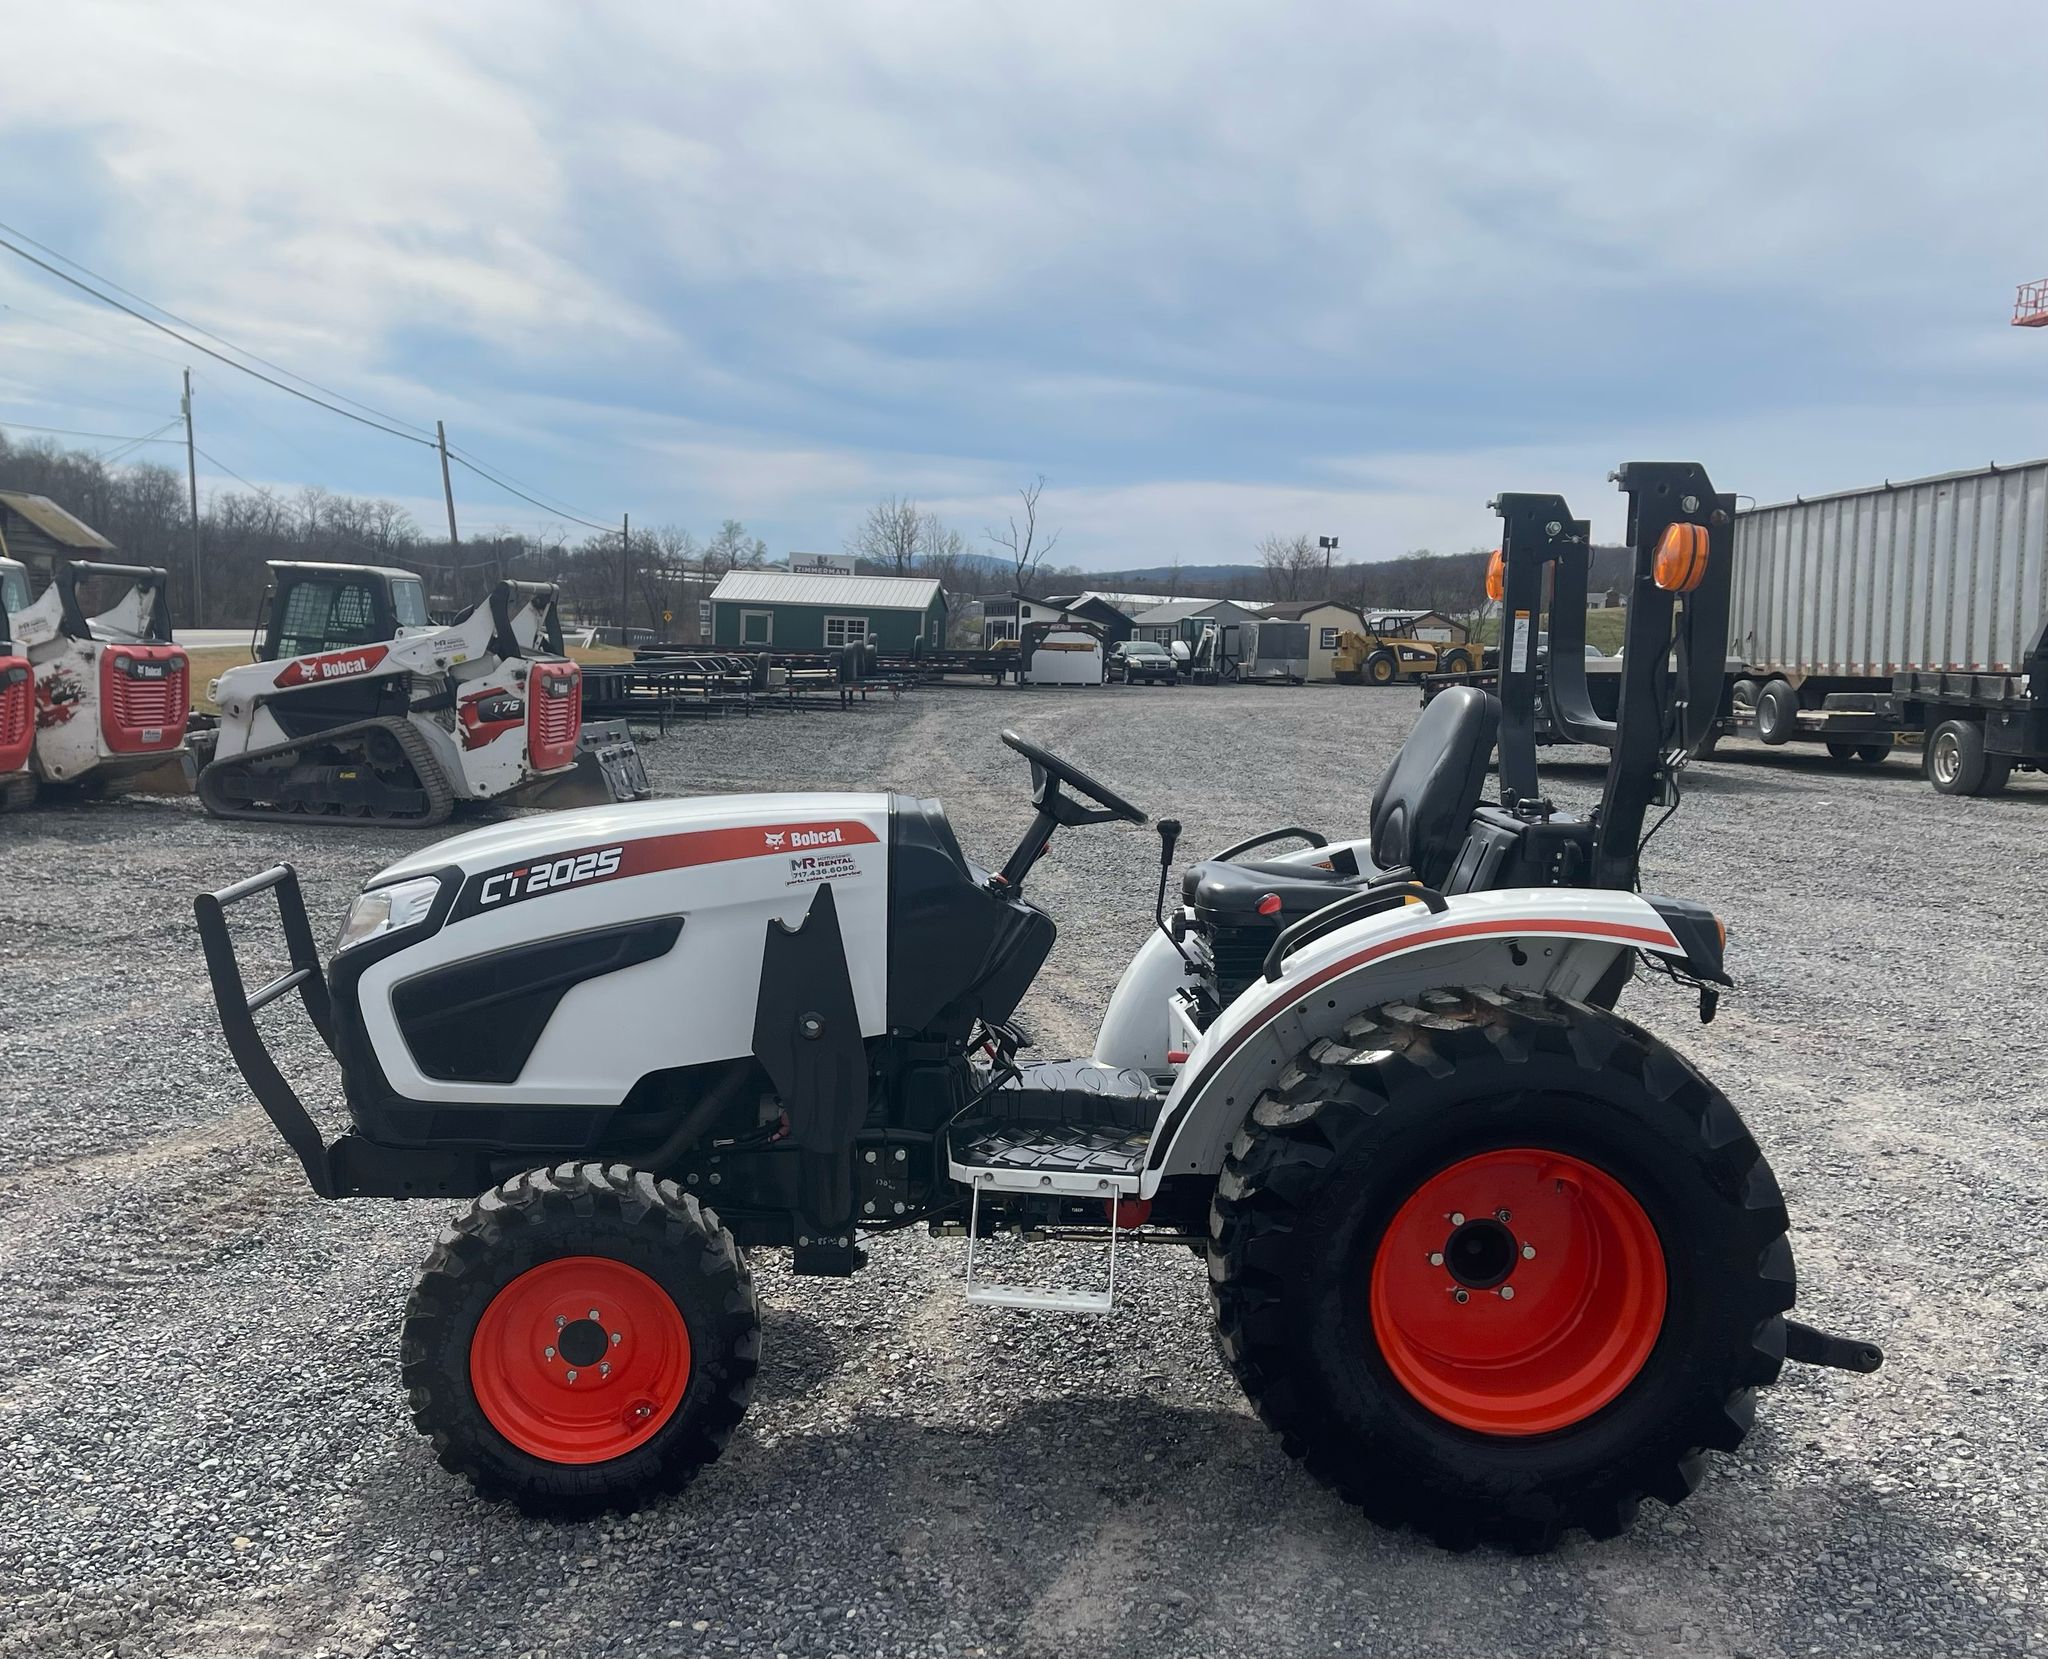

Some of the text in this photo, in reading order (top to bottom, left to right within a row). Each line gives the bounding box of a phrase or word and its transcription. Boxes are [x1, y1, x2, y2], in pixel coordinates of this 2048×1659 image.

[796, 566, 848, 575] ZIMMERMAN
[322, 657, 367, 678] Bobcat
[492, 700, 520, 713] T76
[790, 828, 842, 847] Bobcat
[791, 857, 816, 871] MR
[818, 858, 854, 867] RENTAL
[480, 847, 623, 904] CT2025
[793, 864, 855, 878] 717.436.6090
